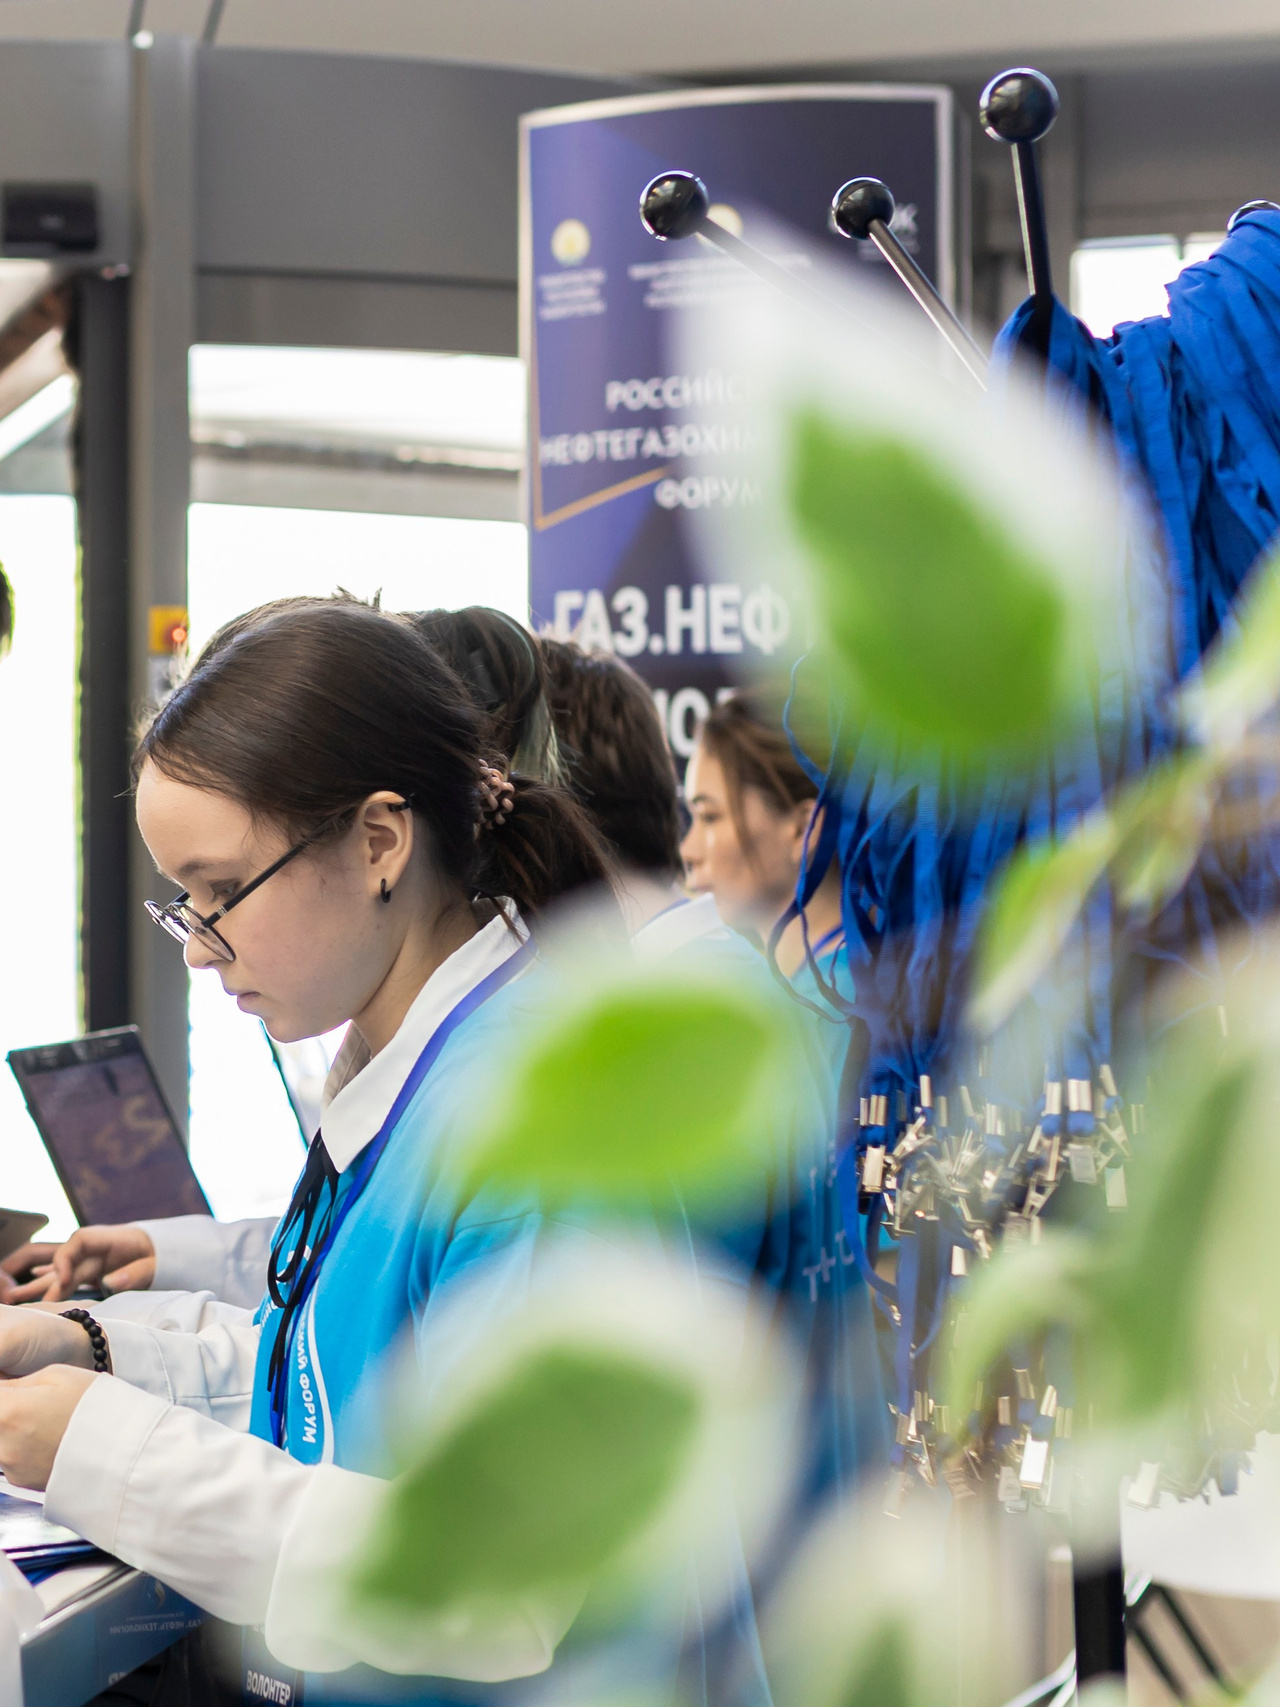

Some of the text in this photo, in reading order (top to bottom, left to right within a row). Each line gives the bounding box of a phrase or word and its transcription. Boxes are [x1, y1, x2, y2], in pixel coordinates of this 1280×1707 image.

[606, 371, 754, 413] РОССИЙС
[654, 474, 763, 510] ФОРУМ
[553, 583, 812, 657] ГАЗ.НЕФ
[299, 1373, 317, 1444] ФОРУМ
[246, 1669, 291, 1706] ВОЛОНТЕР
